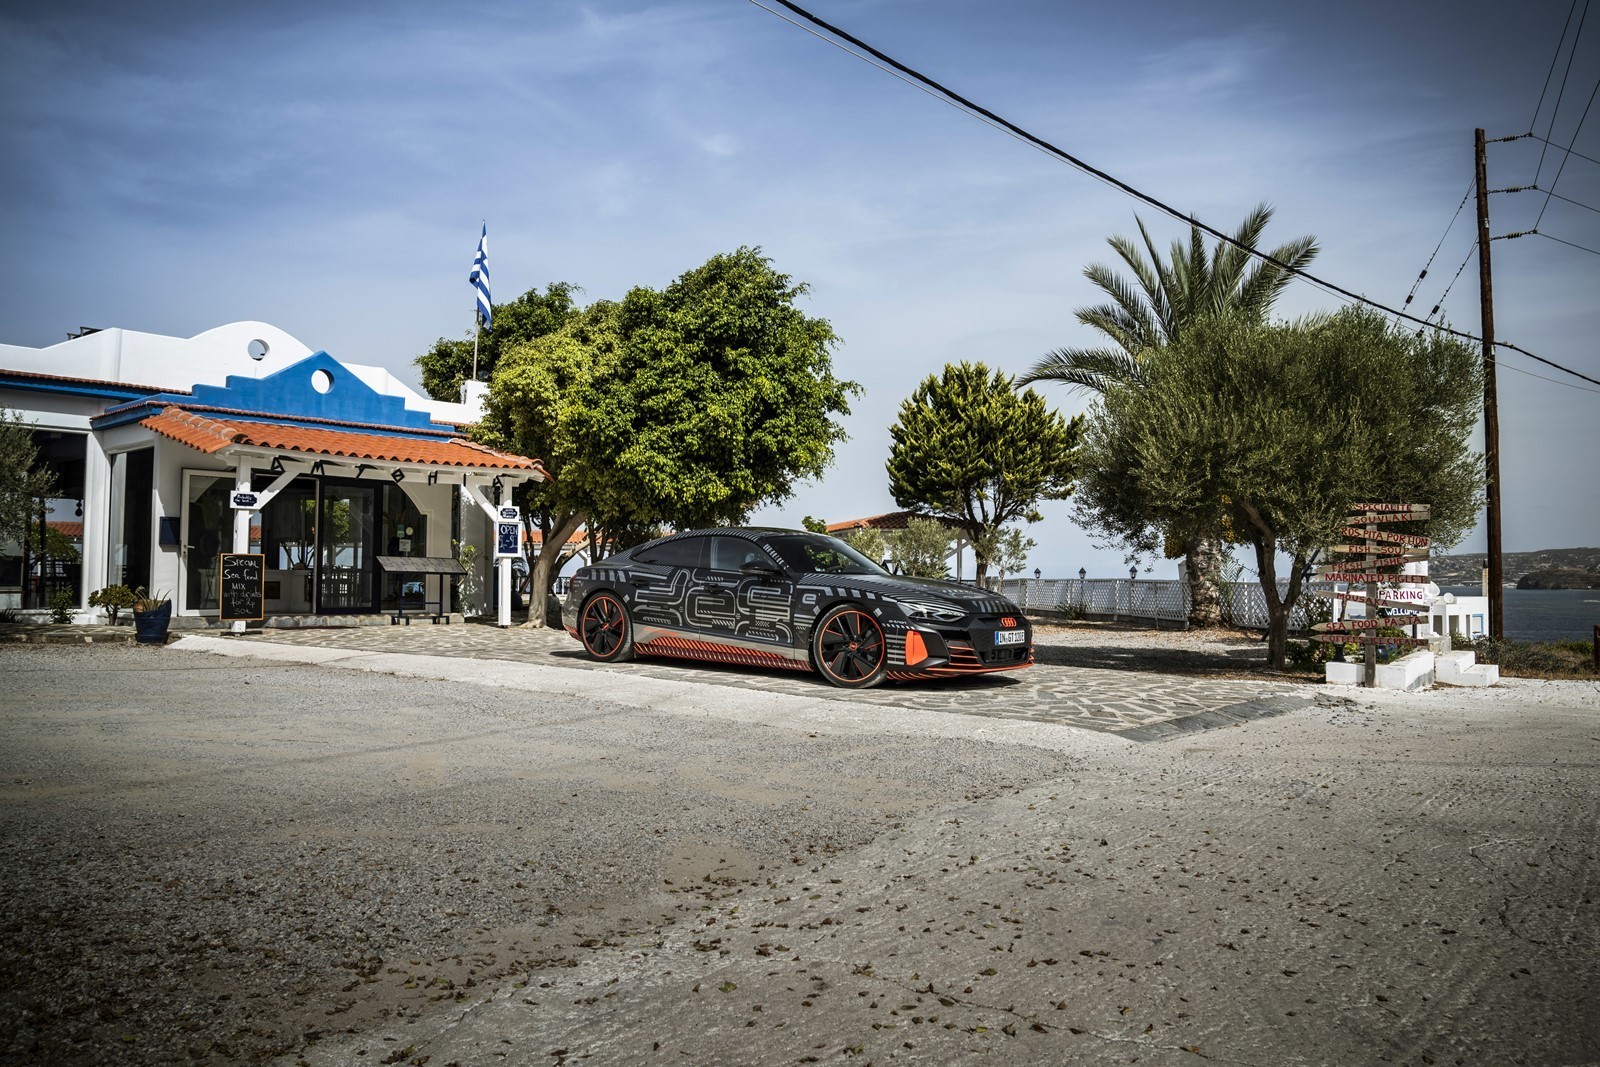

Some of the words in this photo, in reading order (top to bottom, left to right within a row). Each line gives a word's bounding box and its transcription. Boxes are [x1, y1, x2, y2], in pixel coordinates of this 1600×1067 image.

[1354, 514, 1412, 524] SOUVLAKI
[500, 525, 518, 534] OPEN
[1363, 530, 1382, 540] PITA
[1387, 532, 1428, 548] PORTION
[1380, 546, 1410, 554] SOUP
[1331, 562, 1362, 572] FRESH
[1374, 556, 1409, 568] FISHES
[223, 569, 240, 579] Sea
[1325, 573, 1384, 582] MARINATED
[1388, 574, 1425, 584] PIGLET
[1336, 592, 1388, 606] MOUSAKA
[1378, 590, 1422, 600] PARKING
[1326, 621, 1346, 632] SEA
[1352, 620, 1378, 629] FOOD
[1385, 615, 1422, 627] PASTA
[1370, 636, 1386, 645] ICE
